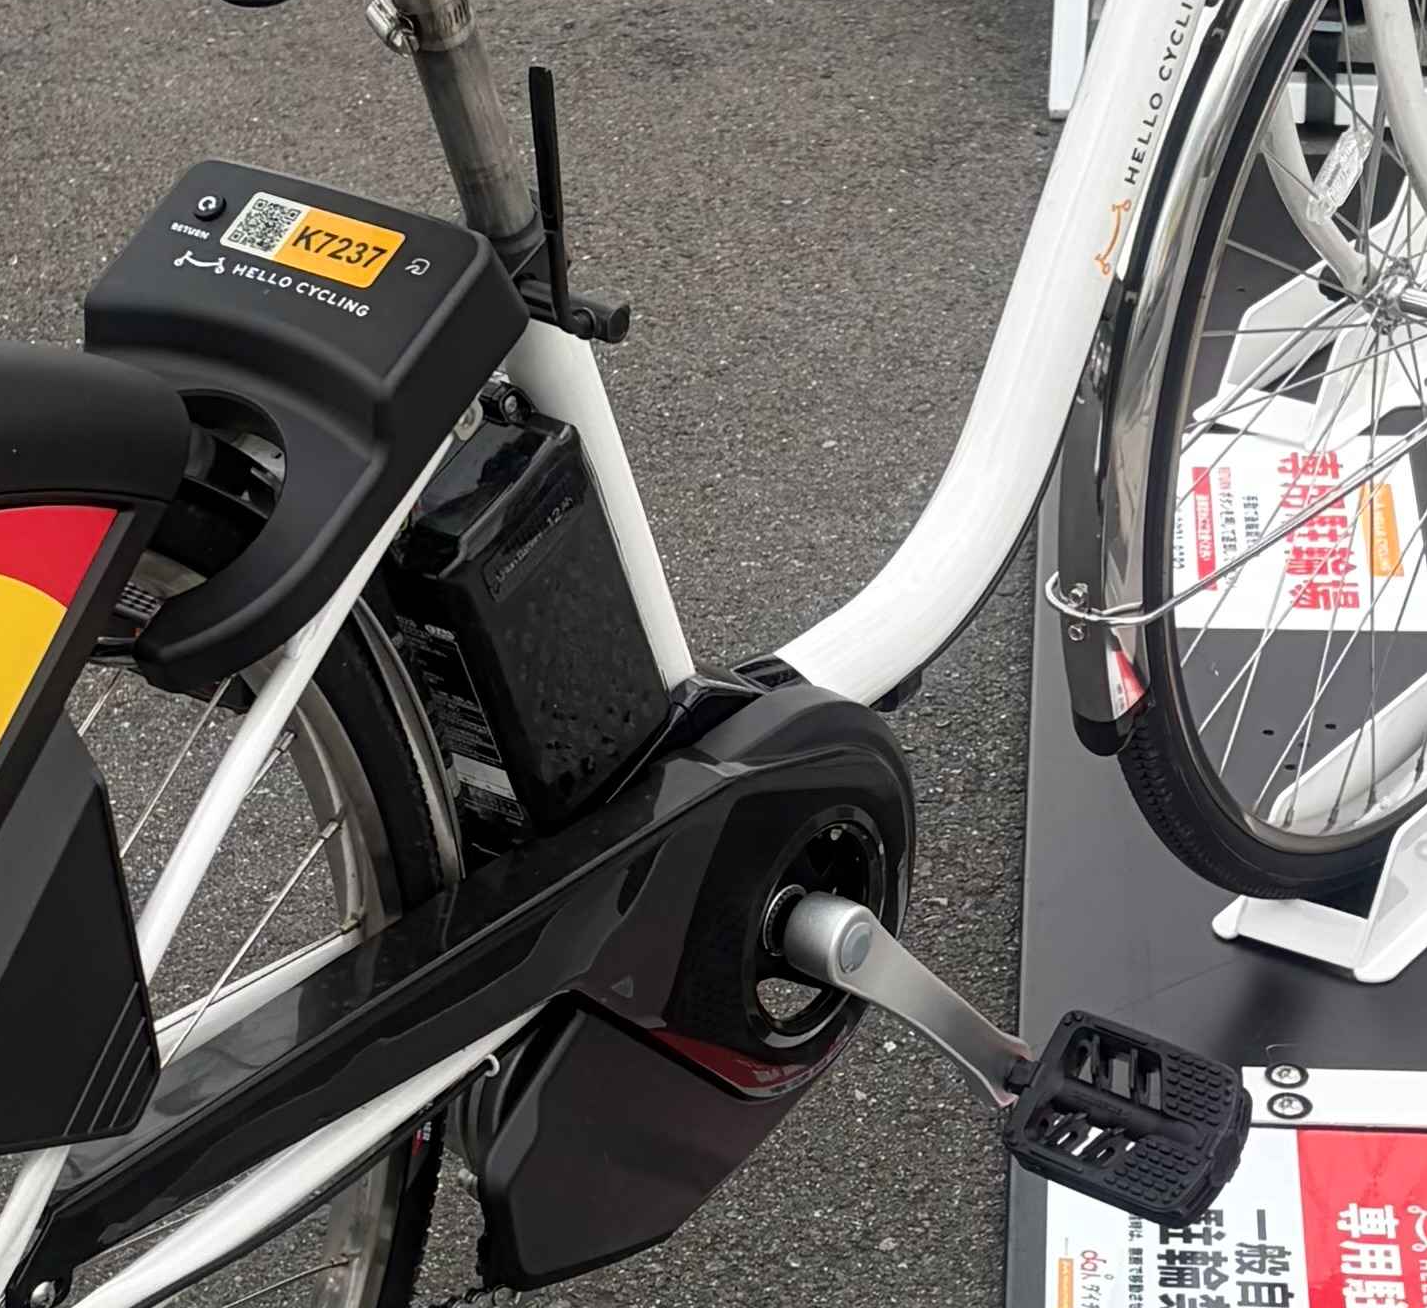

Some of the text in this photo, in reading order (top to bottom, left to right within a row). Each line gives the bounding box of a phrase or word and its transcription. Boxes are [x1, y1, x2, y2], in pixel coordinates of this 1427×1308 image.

[1124, 93, 1163, 185] HELLO
[170, 222, 211, 240] RETURN
[291, 225, 387, 269] K7237
[232, 263, 371, 317] HELLO CYCLING
